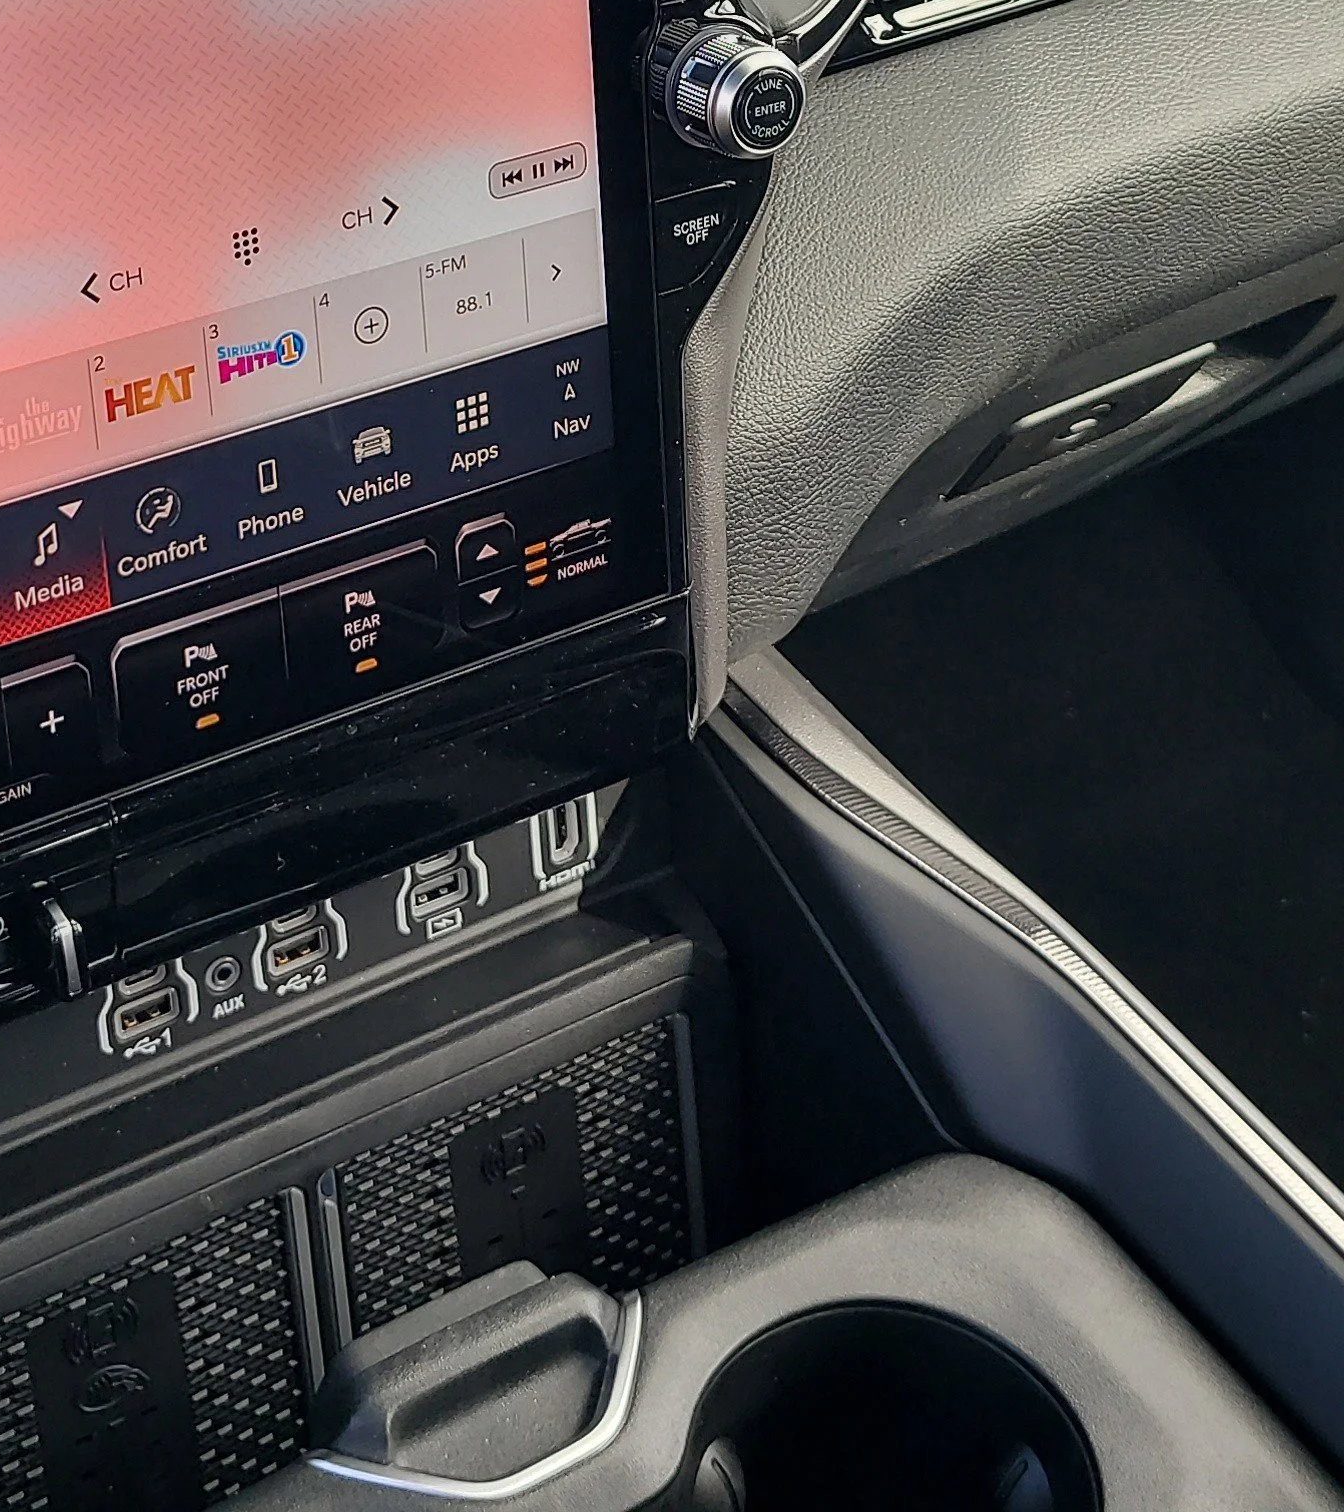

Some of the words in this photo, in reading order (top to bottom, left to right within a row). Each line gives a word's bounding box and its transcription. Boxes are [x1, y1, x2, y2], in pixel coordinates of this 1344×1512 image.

[753, 78, 784, 95] TUNE
[754, 100, 787, 117] ENTER
[750, 118, 791, 139] SCROLL
[342, 207, 374, 231] CH
[672, 213, 721, 237] SCREEN
[685, 229, 710, 246] OFF
[424, 254, 468, 279] 5-FM
[108, 267, 144, 292] CH
[318, 292, 330, 309] 4
[455, 292, 494, 316] 88.1
[208, 323, 220, 340] 3
[93, 355, 106, 373] 2
[555, 358, 581, 379] NW
[104, 364, 196, 424] HEAT
[25, 396, 51, 419] the
[553, 414, 591, 440] Nav
[449, 443, 500, 473] Apps
[337, 470, 412, 507] Vehicle
[237, 507, 305, 541] Phone
[116, 533, 208, 578] Comfort
[556, 553, 609, 581] NORMAL
[13, 573, 85, 612] Media
[342, 612, 381, 638] REAR
[348, 632, 378, 653] OFF
[176, 664, 230, 695] FRONT
[188, 686, 220, 709] OFF
[312, 965, 328, 986] 2
[212, 992, 246, 1020] AUX
[161, 1030, 174, 1050] 1
